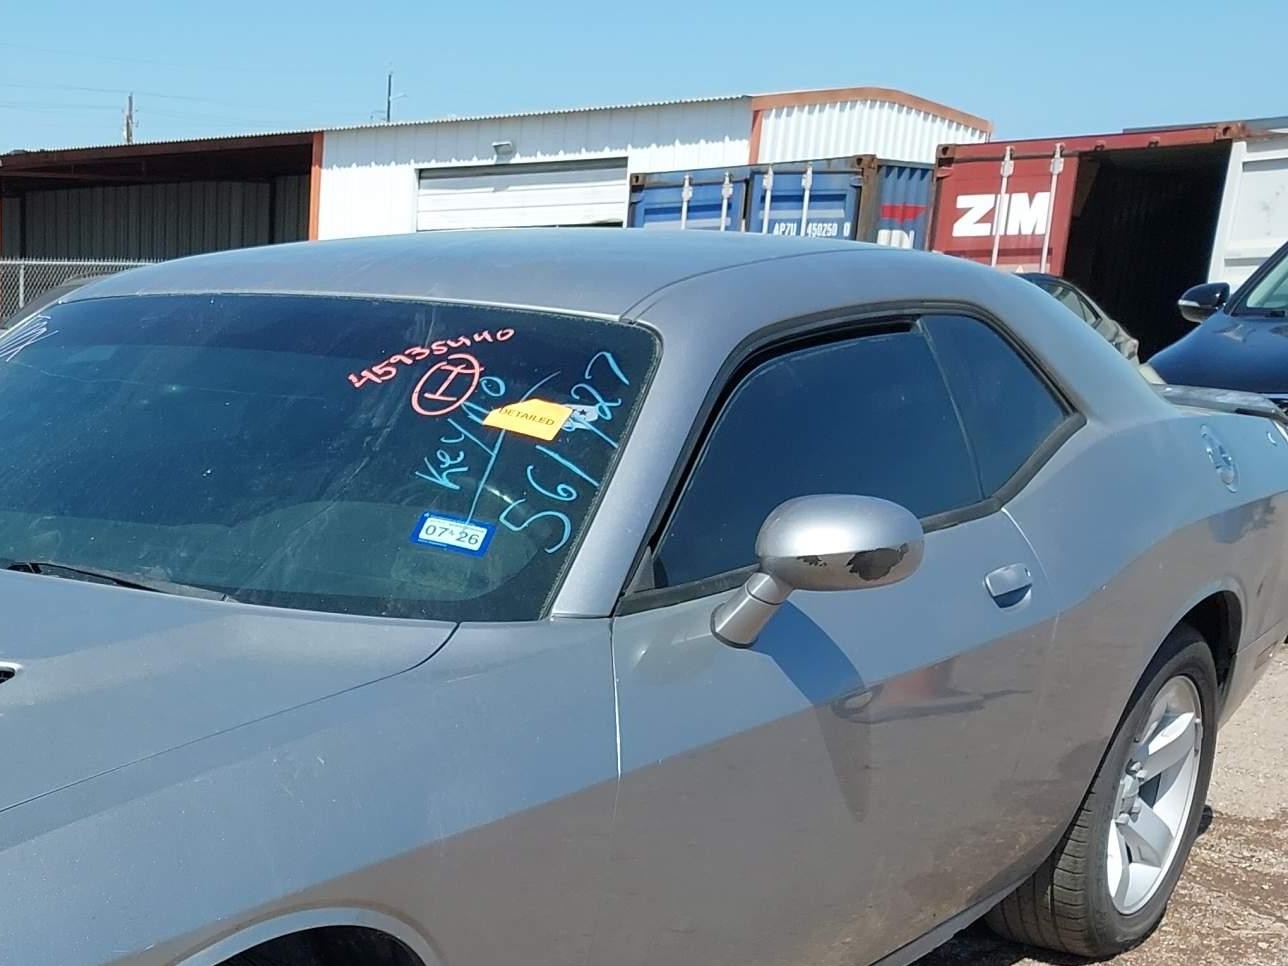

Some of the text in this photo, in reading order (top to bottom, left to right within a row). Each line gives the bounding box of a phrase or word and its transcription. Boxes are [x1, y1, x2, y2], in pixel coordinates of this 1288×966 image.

[952, 191, 1051, 237] ZIM
[498, 407, 555, 426] DETAILED
[425, 524, 480, 545] 07 26
